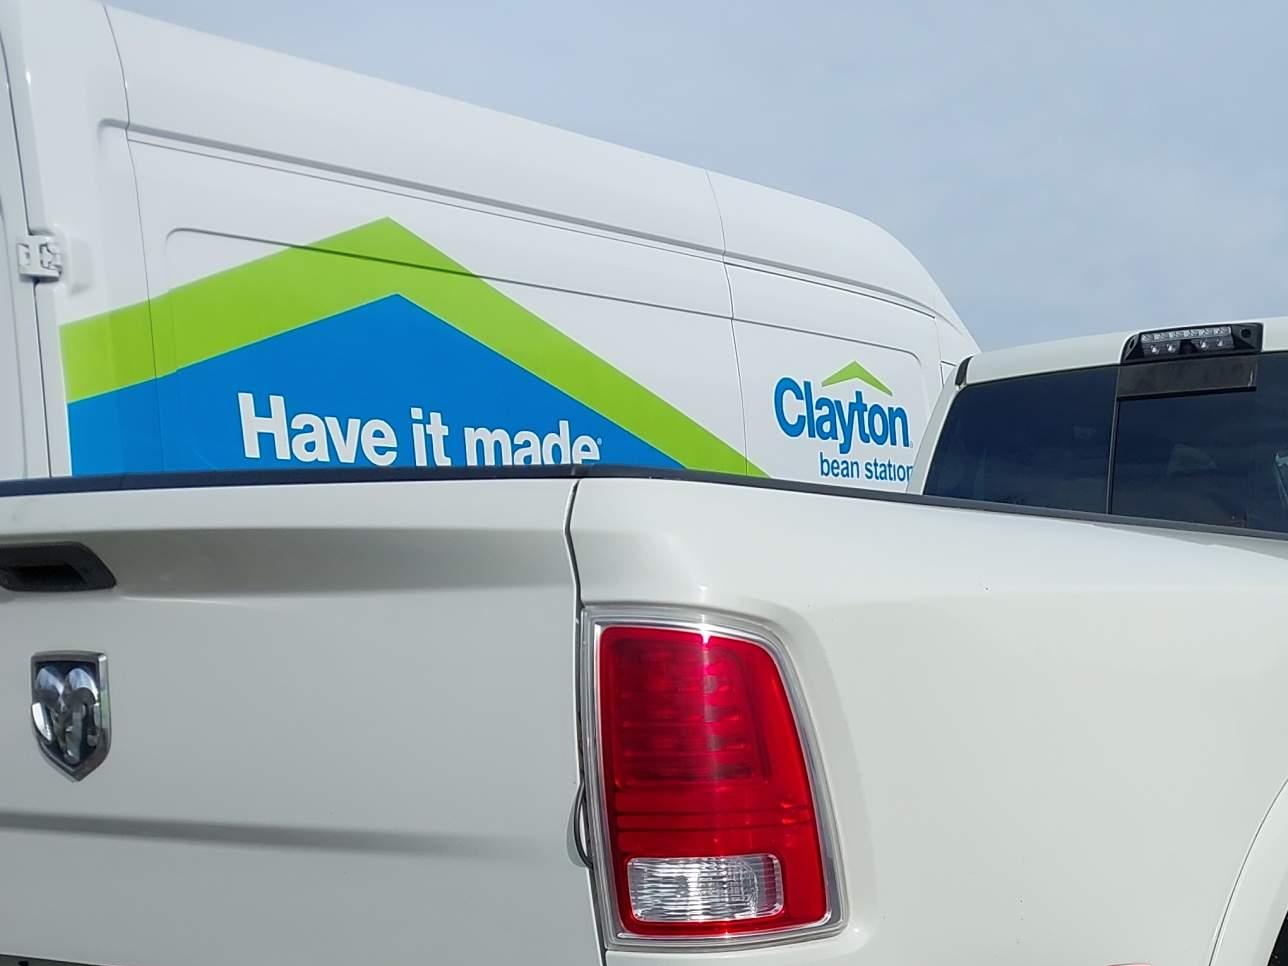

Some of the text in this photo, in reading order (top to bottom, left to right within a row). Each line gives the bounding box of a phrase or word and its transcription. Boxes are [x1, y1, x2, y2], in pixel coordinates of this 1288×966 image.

[238, 392, 600, 467] Have it made
[774, 376, 910, 454] Clayton
[820, 452, 860, 479] bean
